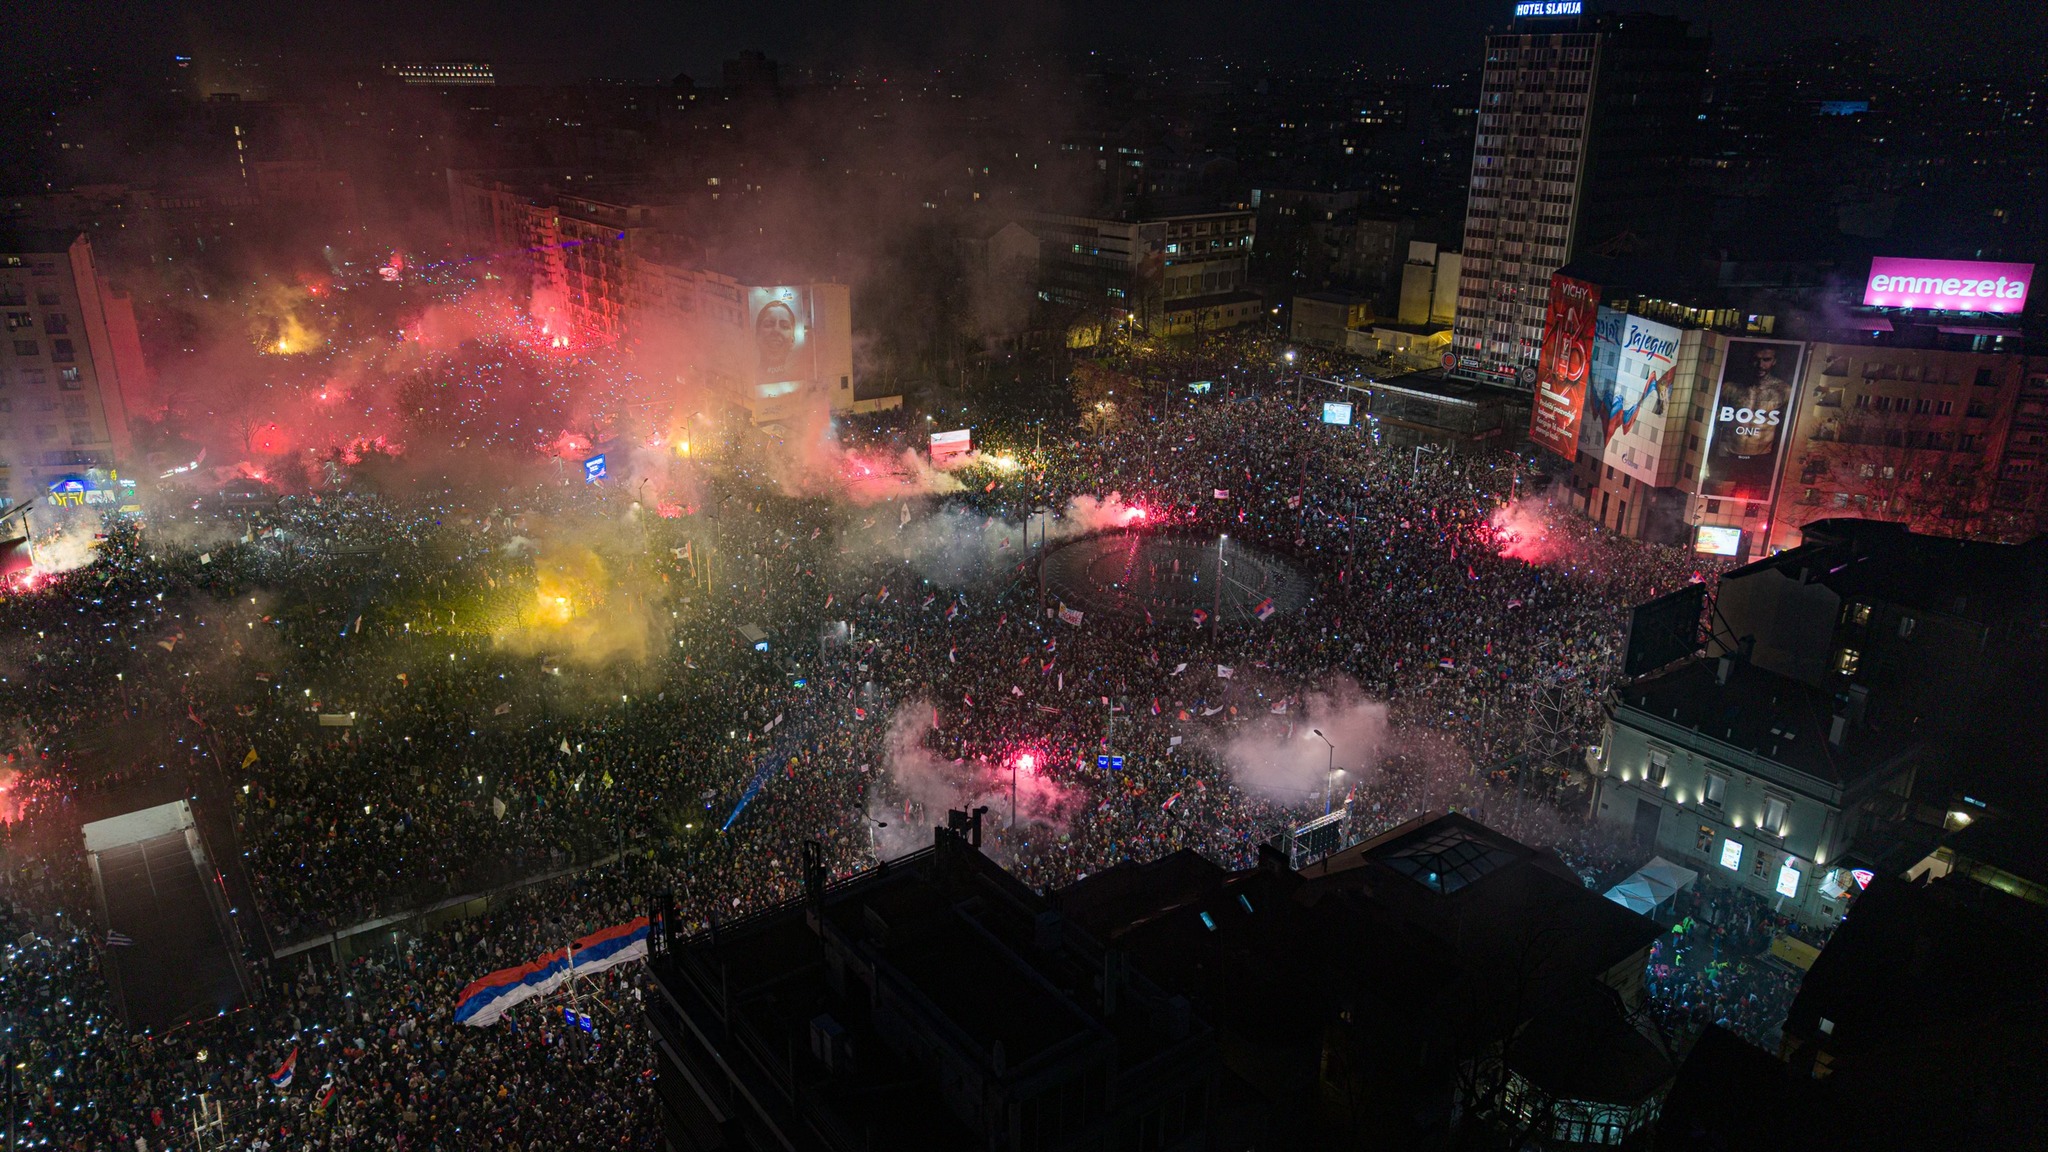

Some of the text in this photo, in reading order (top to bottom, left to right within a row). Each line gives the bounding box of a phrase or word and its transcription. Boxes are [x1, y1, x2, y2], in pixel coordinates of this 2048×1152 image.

[1516, 1, 1582, 16] HOTEL SLAVIJA
[1562, 282, 1588, 299] VICHY
[1871, 273, 2026, 299] emmezeta
[1719, 406, 1781, 426] BOSS
[1735, 426, 1761, 437] ONE
